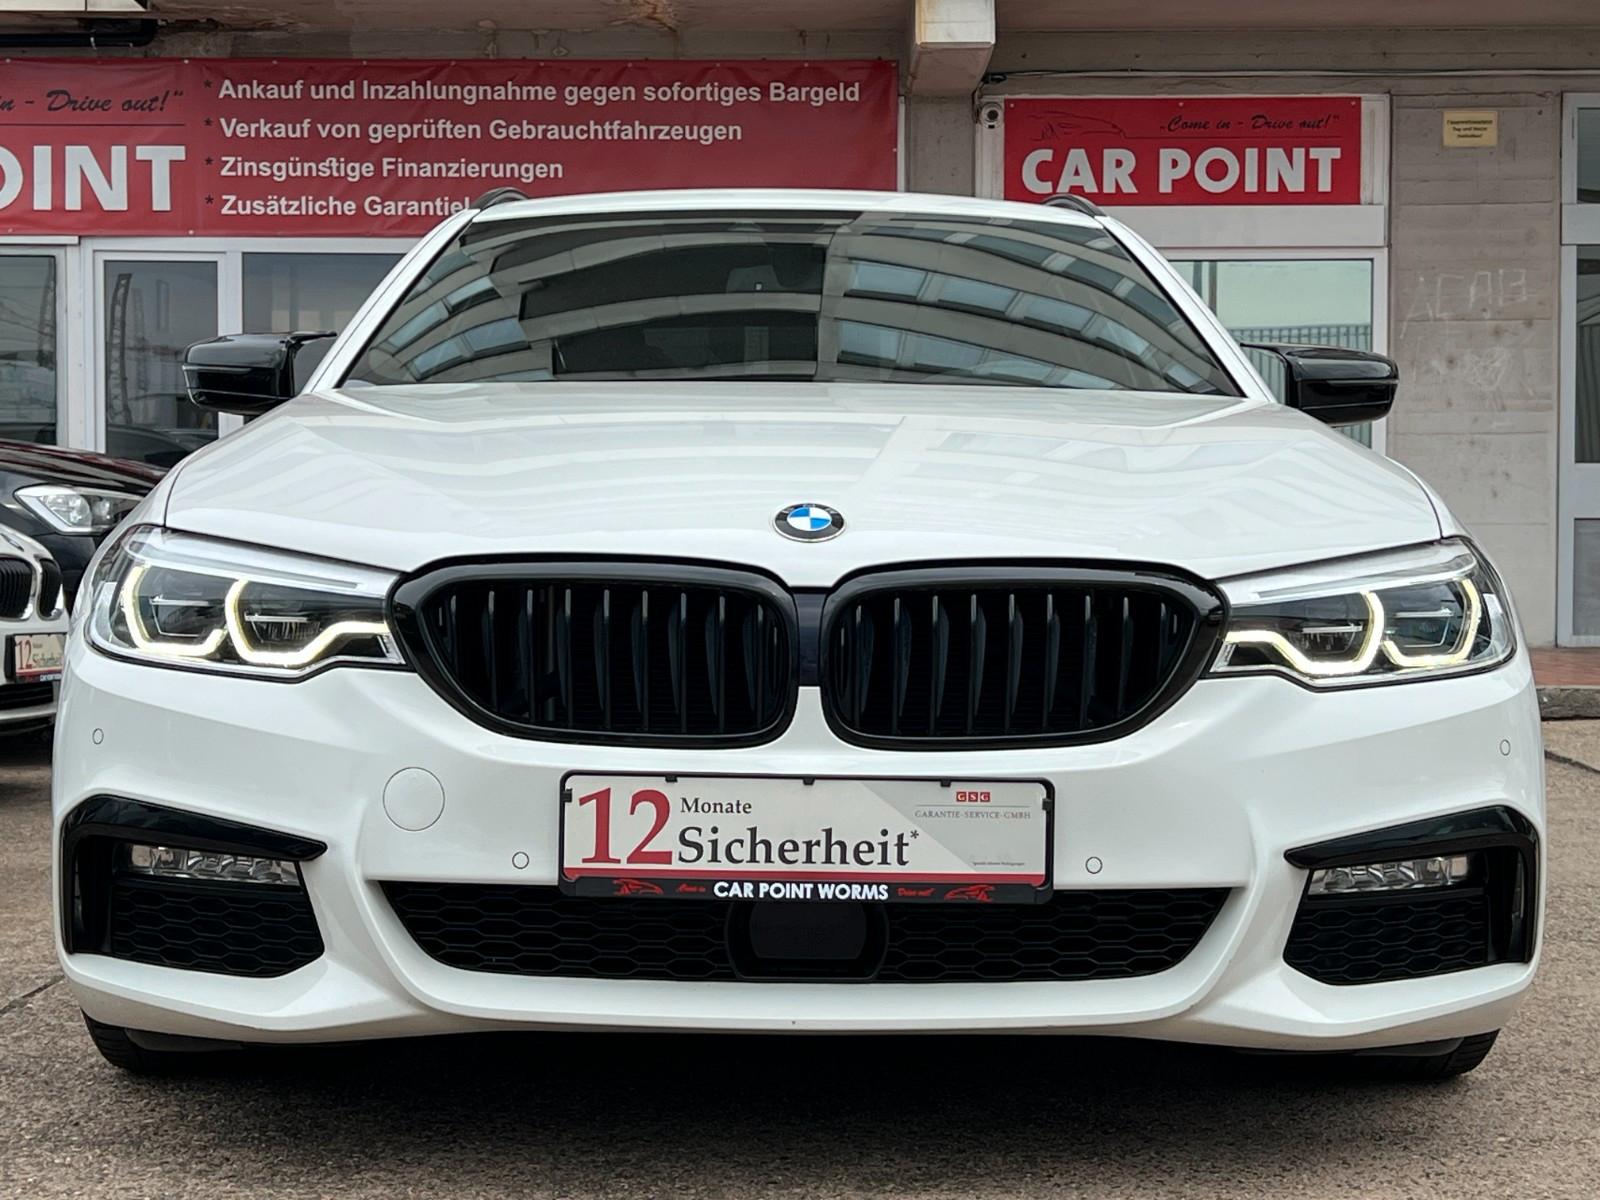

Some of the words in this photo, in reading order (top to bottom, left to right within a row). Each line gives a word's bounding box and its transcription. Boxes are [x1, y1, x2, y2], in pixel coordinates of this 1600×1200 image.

[46, 89, 112, 112] Drive
[218, 80, 304, 100] Ankauf
[310, 81, 355, 100] und
[363, 81, 557, 105] Inzahlungnahme
[564, 86, 636, 106] gegen
[643, 81, 762, 107] sofortiges
[769, 82, 860, 107] Bargeld
[219, 117, 312, 139] Verkauf
[316, 123, 361, 139] von
[368, 119, 481, 144] geprüften
[489, 119, 742, 145] Gebrauchtfahrzeugen
[1216, 119, 1231, 130] in
[1251, 114, 1293, 130] Drive
[220, 156, 375, 182] Zinsgünstige
[382, 157, 563, 183] Finanzierungen
[1021, 148, 1138, 194] CAR
[1159, 147, 1342, 194] POINT
[220, 194, 357, 217] Zusätzliche
[15, 639, 32, 670] 12
[681, 797, 752, 815] Monate
[957, 792, 990, 802] GSG
[578, 787, 673, 865] 12
[713, 881, 754, 898] CAR
[759, 882, 814, 899] POINT
[817, 883, 889, 900] WORMS
